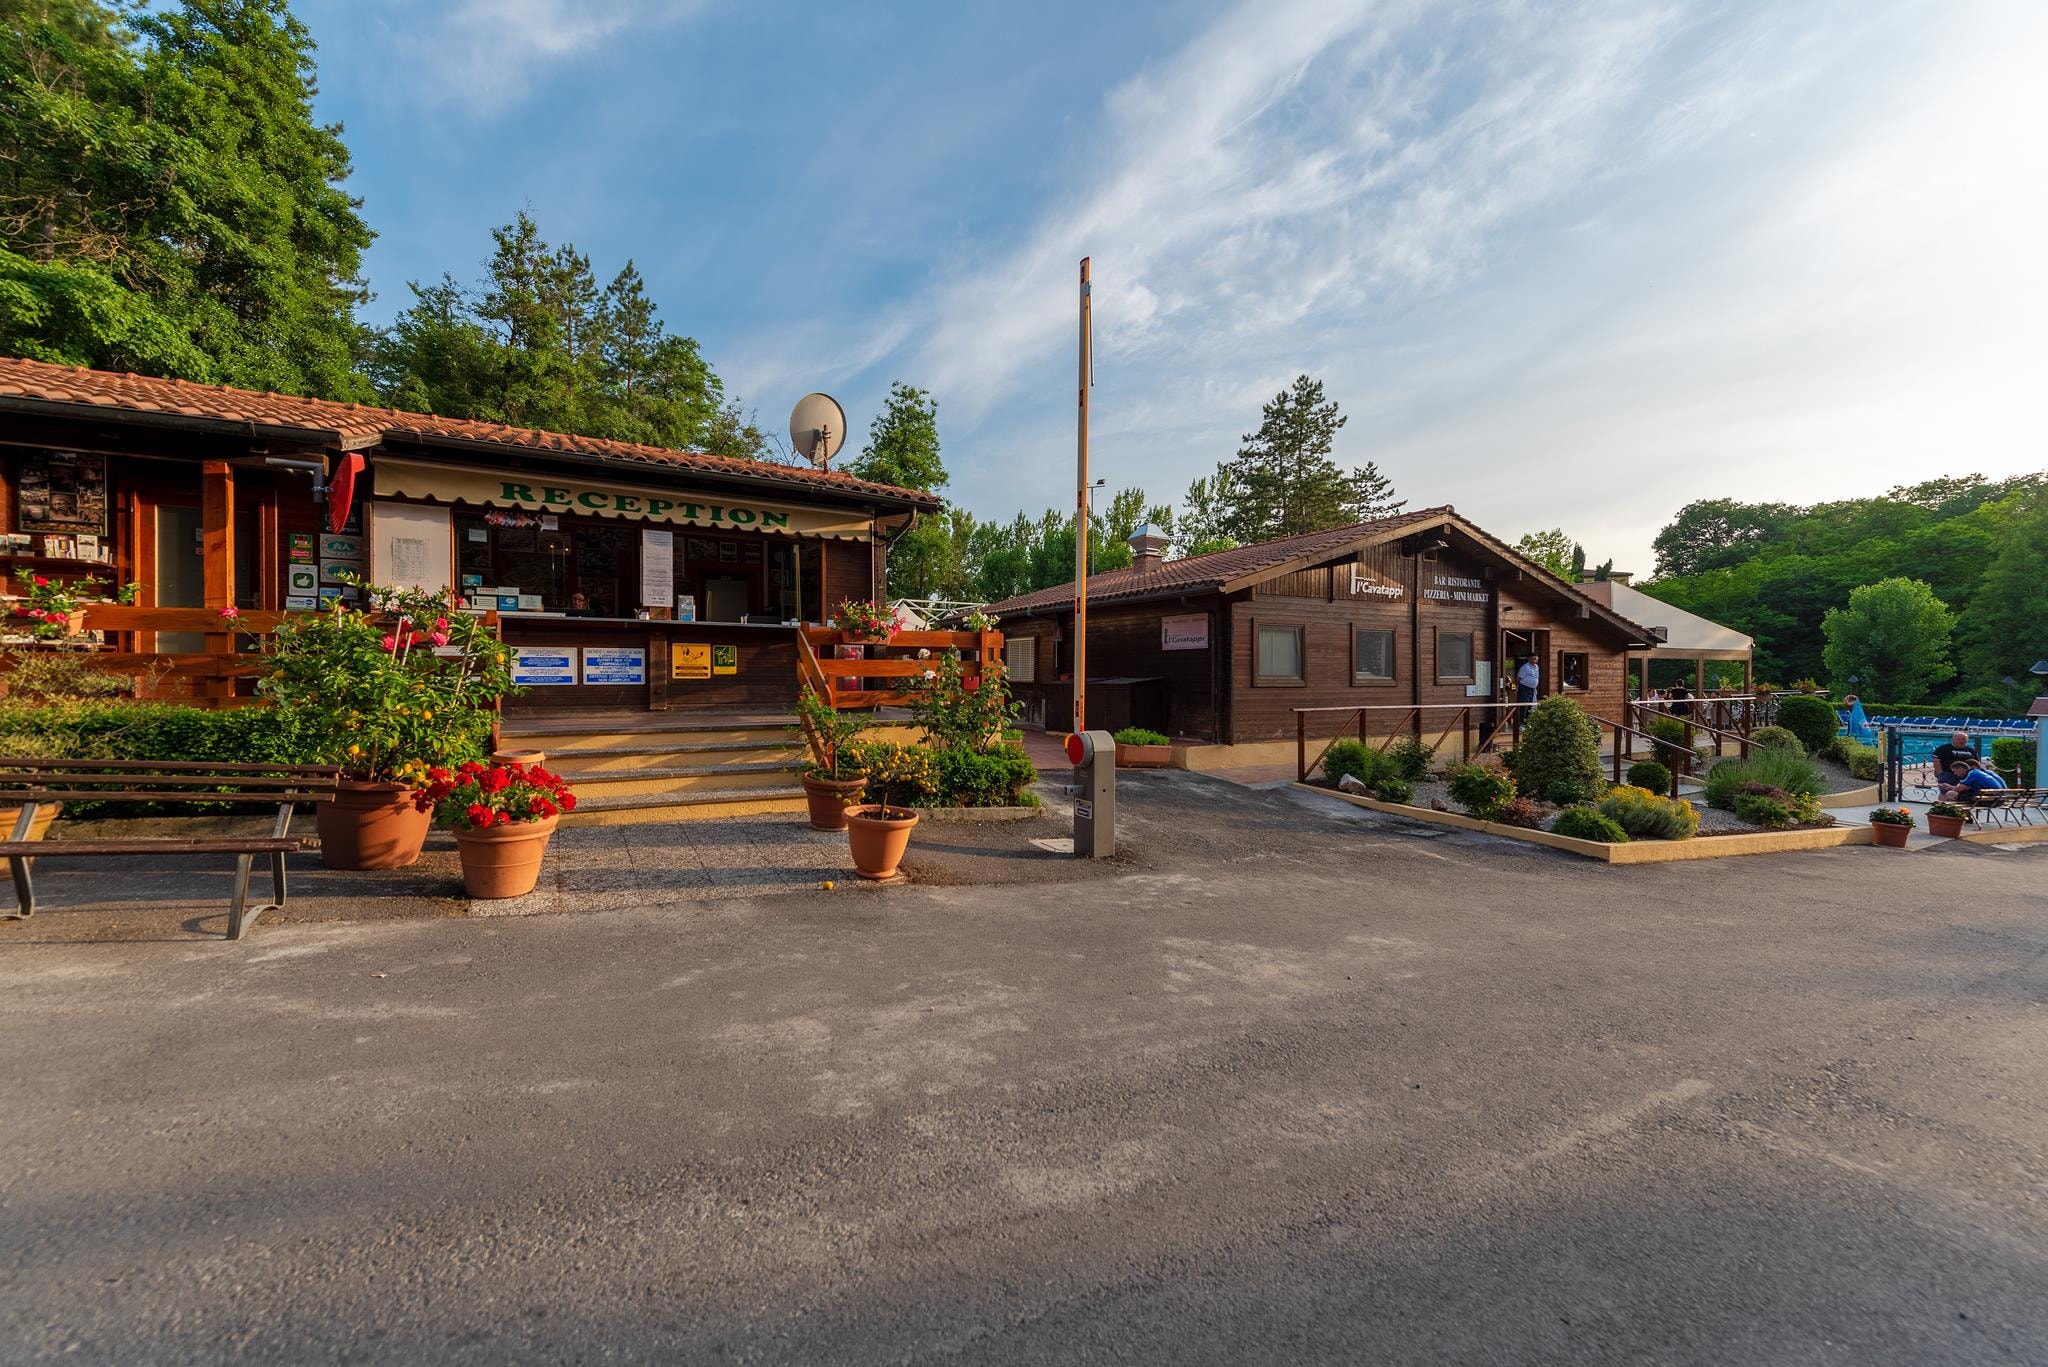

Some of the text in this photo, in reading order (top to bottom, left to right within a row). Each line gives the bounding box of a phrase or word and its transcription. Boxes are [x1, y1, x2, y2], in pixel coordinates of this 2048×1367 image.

[500, 482, 789, 528] RECEPTION
[1434, 575, 1481, 589] BAR RISTORANTE
[1423, 589, 1450, 600] PIZZERIA
[1453, 591, 1466, 601] MINI
[1467, 592, 1489, 603] MARKET
